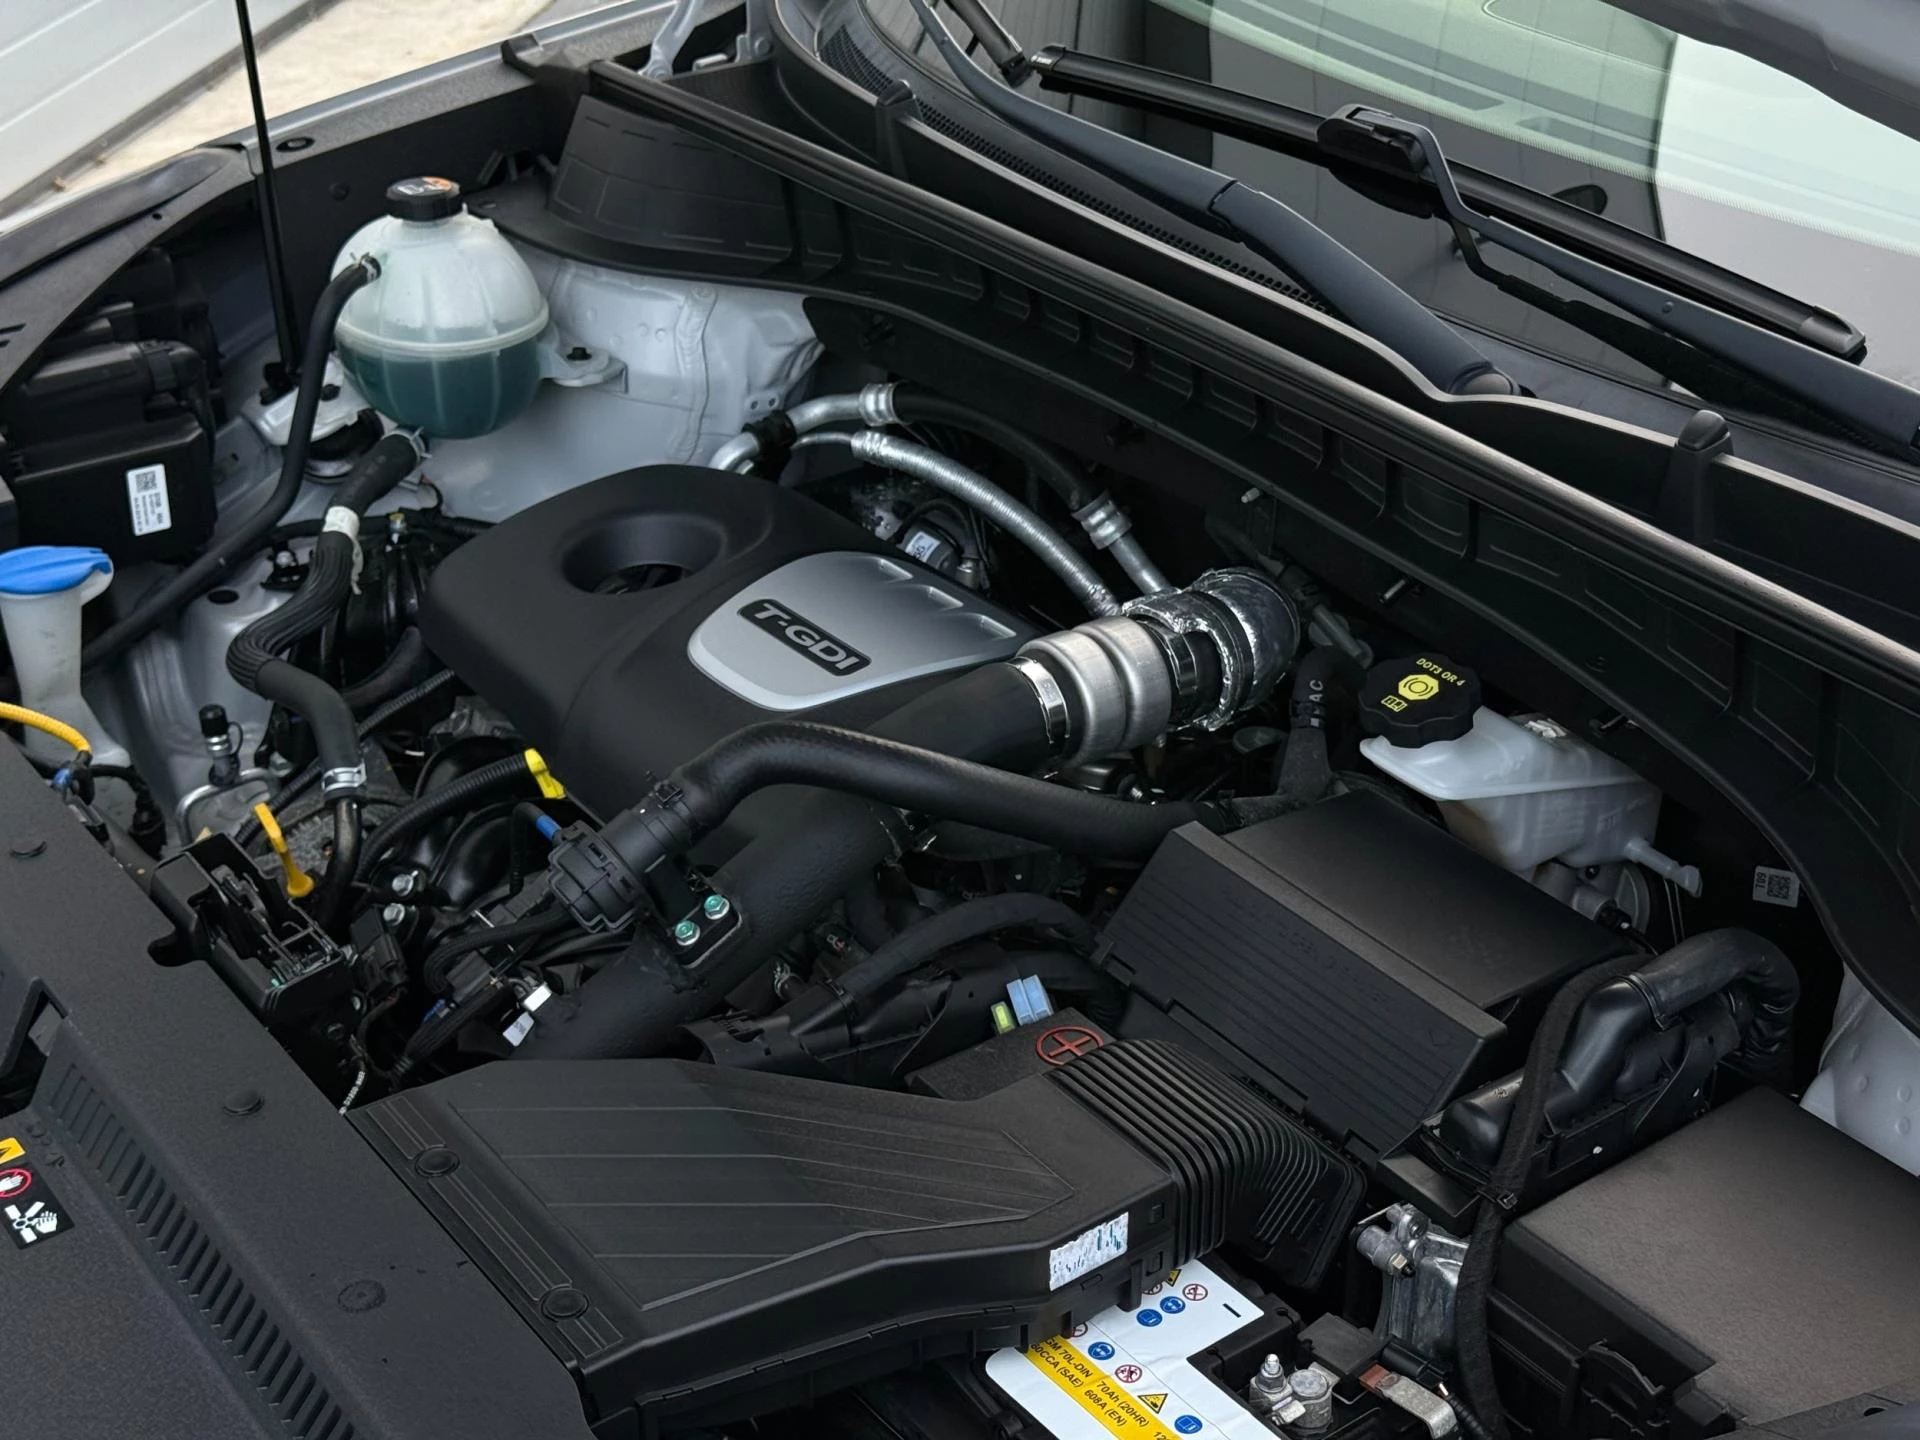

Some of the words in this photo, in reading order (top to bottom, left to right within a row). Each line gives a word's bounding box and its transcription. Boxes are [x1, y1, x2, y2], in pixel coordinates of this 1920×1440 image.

[754, 602, 860, 670] T-GDI
[1416, 658, 1442, 674] DOT3
[1441, 671, 1458, 683] OR
[1031, 1343, 1060, 1369] 60CCA
[1056, 1366, 1084, 1388] (SAE)
[1084, 1389, 1107, 1410] 608A
[1104, 1408, 1127, 1427] (EN)
[1044, 1338, 1062, 1351] GM
[1059, 1348, 1093, 1378] 70L-DIN
[1097, 1380, 1120, 1403] 70Ah
[1117, 1400, 1149, 1427] (20HR)
